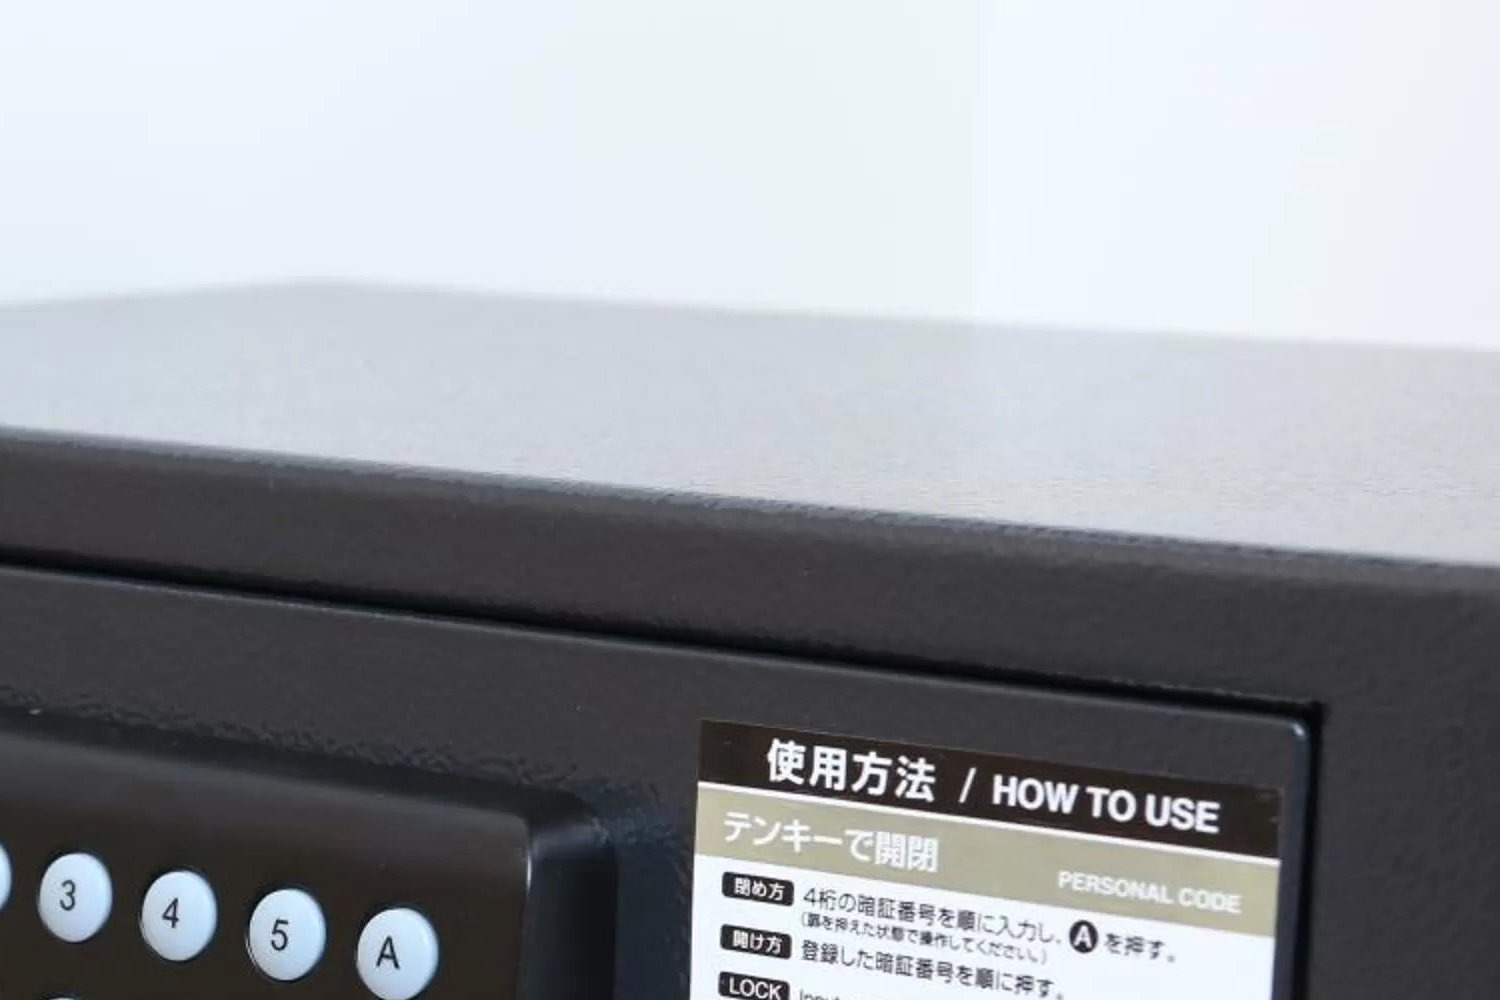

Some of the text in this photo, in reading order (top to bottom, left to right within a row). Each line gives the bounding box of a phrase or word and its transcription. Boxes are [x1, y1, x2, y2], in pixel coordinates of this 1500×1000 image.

[767, 738, 937, 802] 使用方法
[992, 774, 1079, 814] HOW
[1086, 787, 1137, 822] TO
[1145, 794, 1220, 833] USE
[724, 811, 939, 873] テンキーで開閉
[59, 879, 77, 912] 3
[733, 876, 786, 901] 閉め方
[1057, 871, 1242, 913] PERSONAL CODE
[161, 897, 180, 929] 4
[270, 918, 290, 953] 5
[375, 935, 401, 971] A
[731, 929, 783, 954] 開け方
